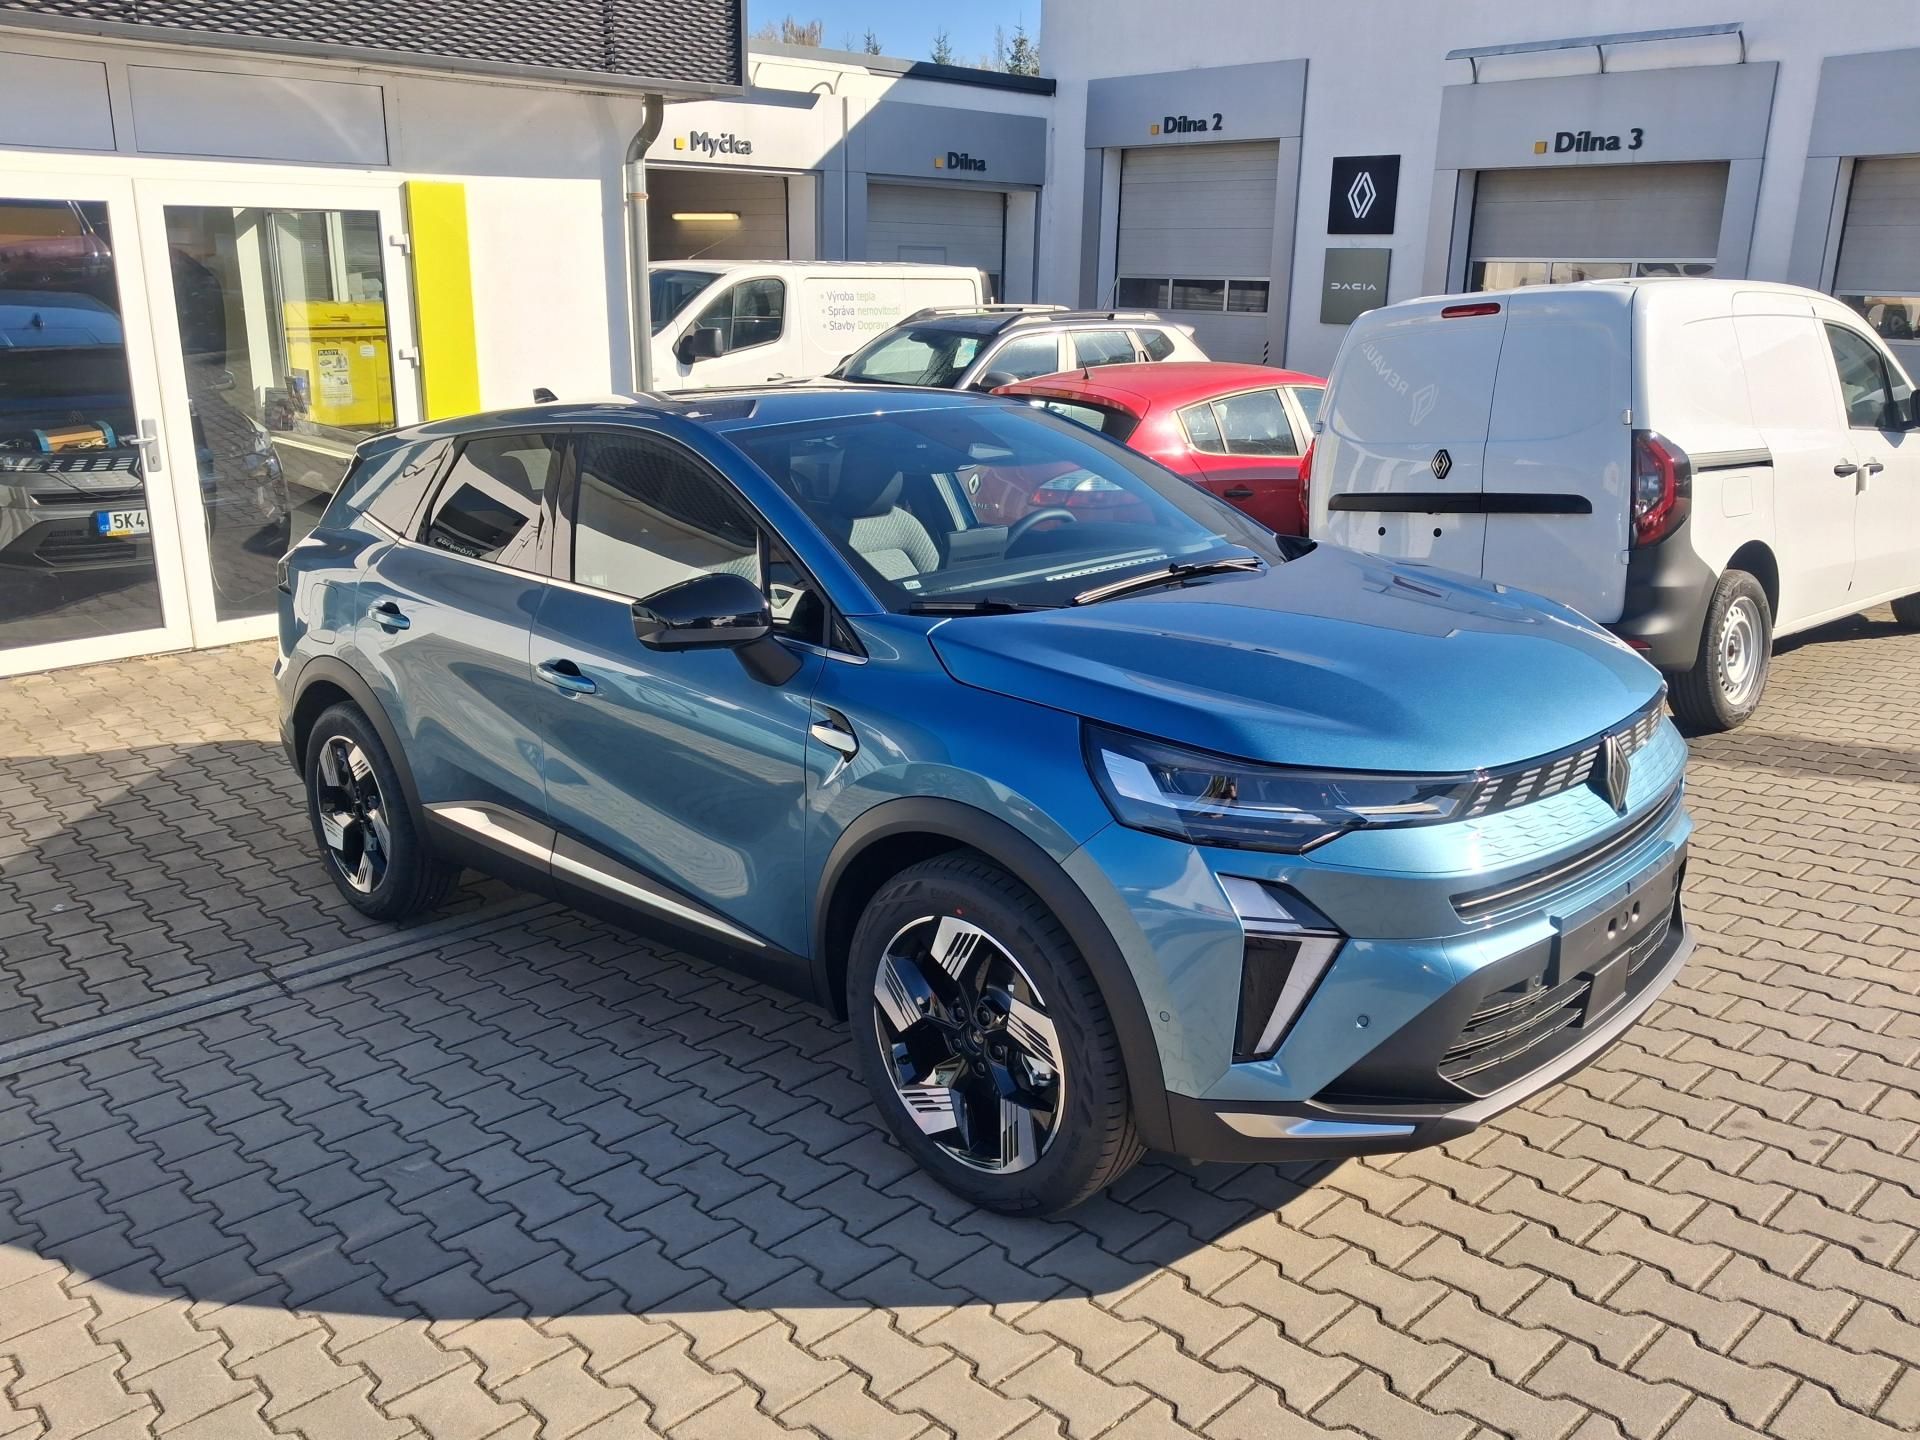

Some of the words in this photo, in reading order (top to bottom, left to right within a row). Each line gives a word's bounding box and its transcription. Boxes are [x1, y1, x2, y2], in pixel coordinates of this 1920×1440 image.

[1163, 115, 1207, 133] Dílna
[1212, 112, 1223, 131] 2
[690, 130, 753, 158] Myčka
[1554, 130, 1622, 153] Dílna
[1628, 128, 1643, 150] 3
[947, 151, 987, 172] Dílna
[1331, 282, 1377, 291] DACIA
[826, 290, 855, 303] Výroba
[856, 290, 876, 304] tepla
[828, 304, 855, 317] Správa
[829, 320, 856, 332] Stavby
[113, 513, 145, 529] 5K4
